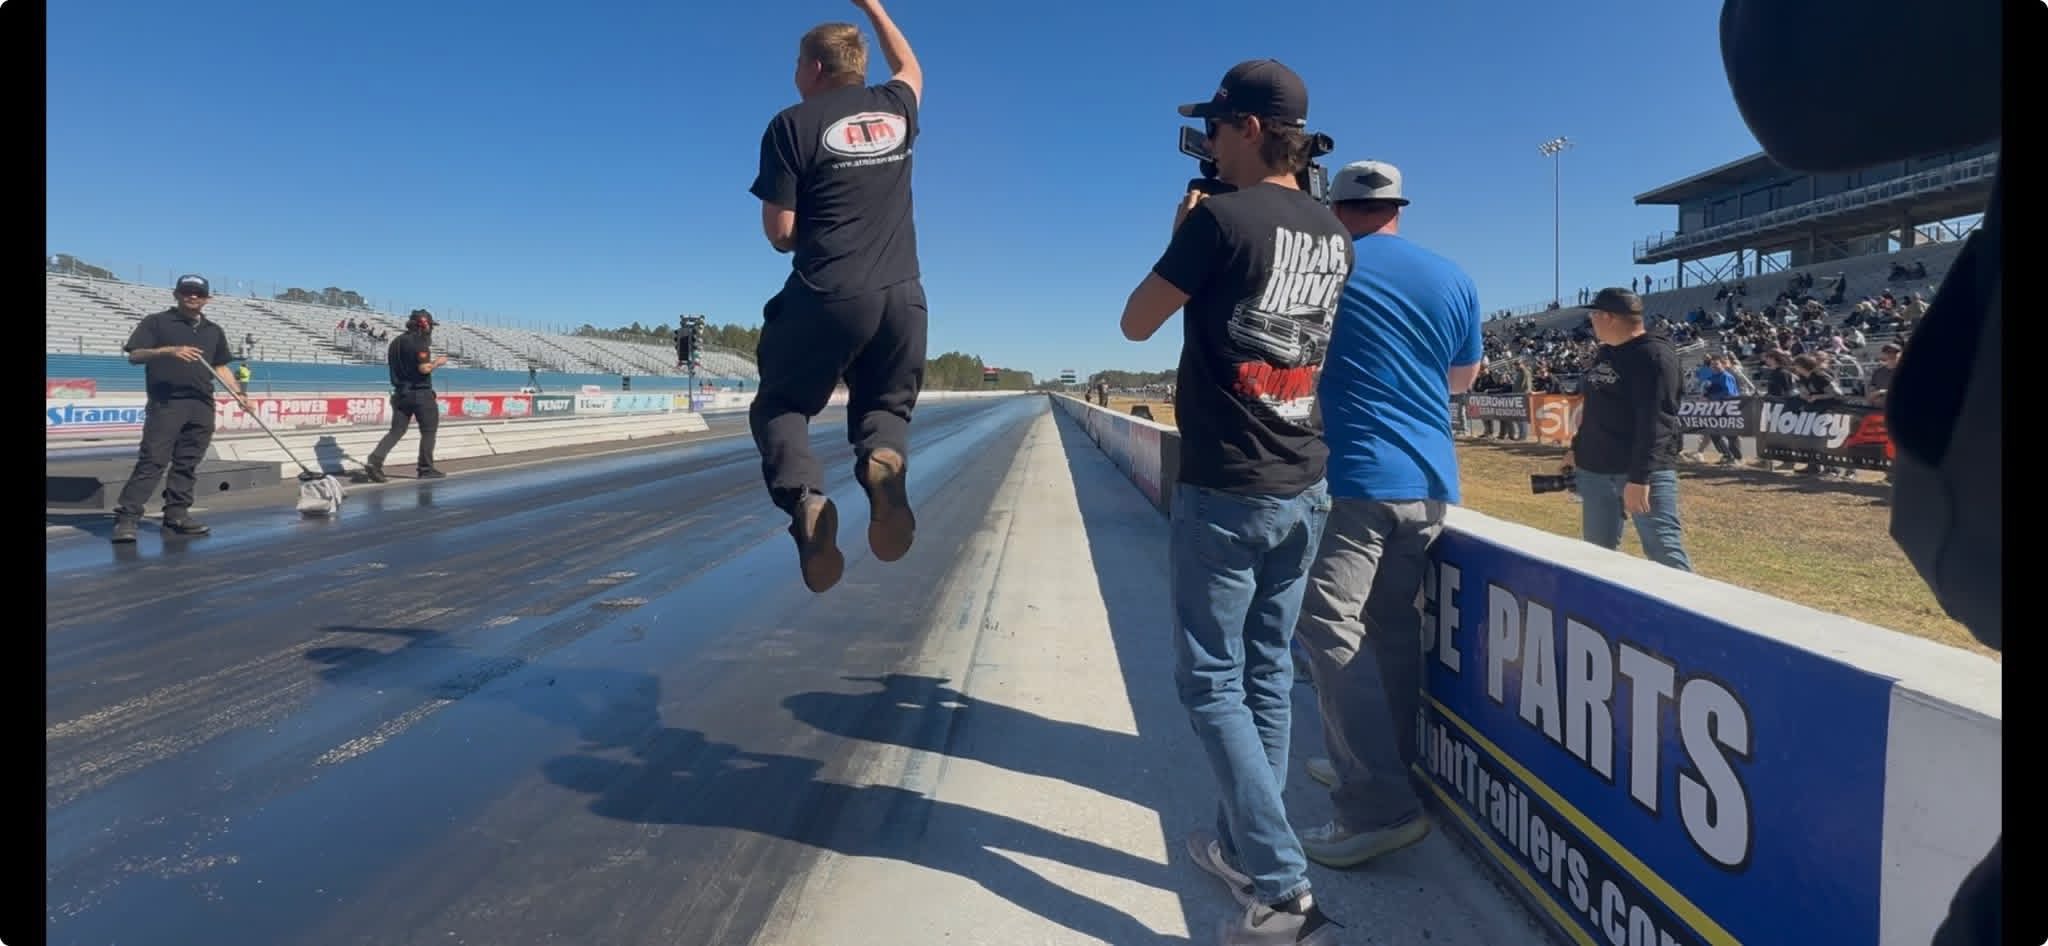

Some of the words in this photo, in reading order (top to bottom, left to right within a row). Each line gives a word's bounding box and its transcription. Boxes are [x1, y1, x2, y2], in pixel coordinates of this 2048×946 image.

[280, 400, 329, 413] POWER
[537, 399, 570, 411] FENDT
[1468, 396, 1525, 408] OVERDRIVE
[1678, 400, 1742, 416] DRIVE
[1682, 416, 1745, 429] VENDORS
[1760, 402, 1850, 449] Holley
[1488, 583, 1750, 867] PARTS
